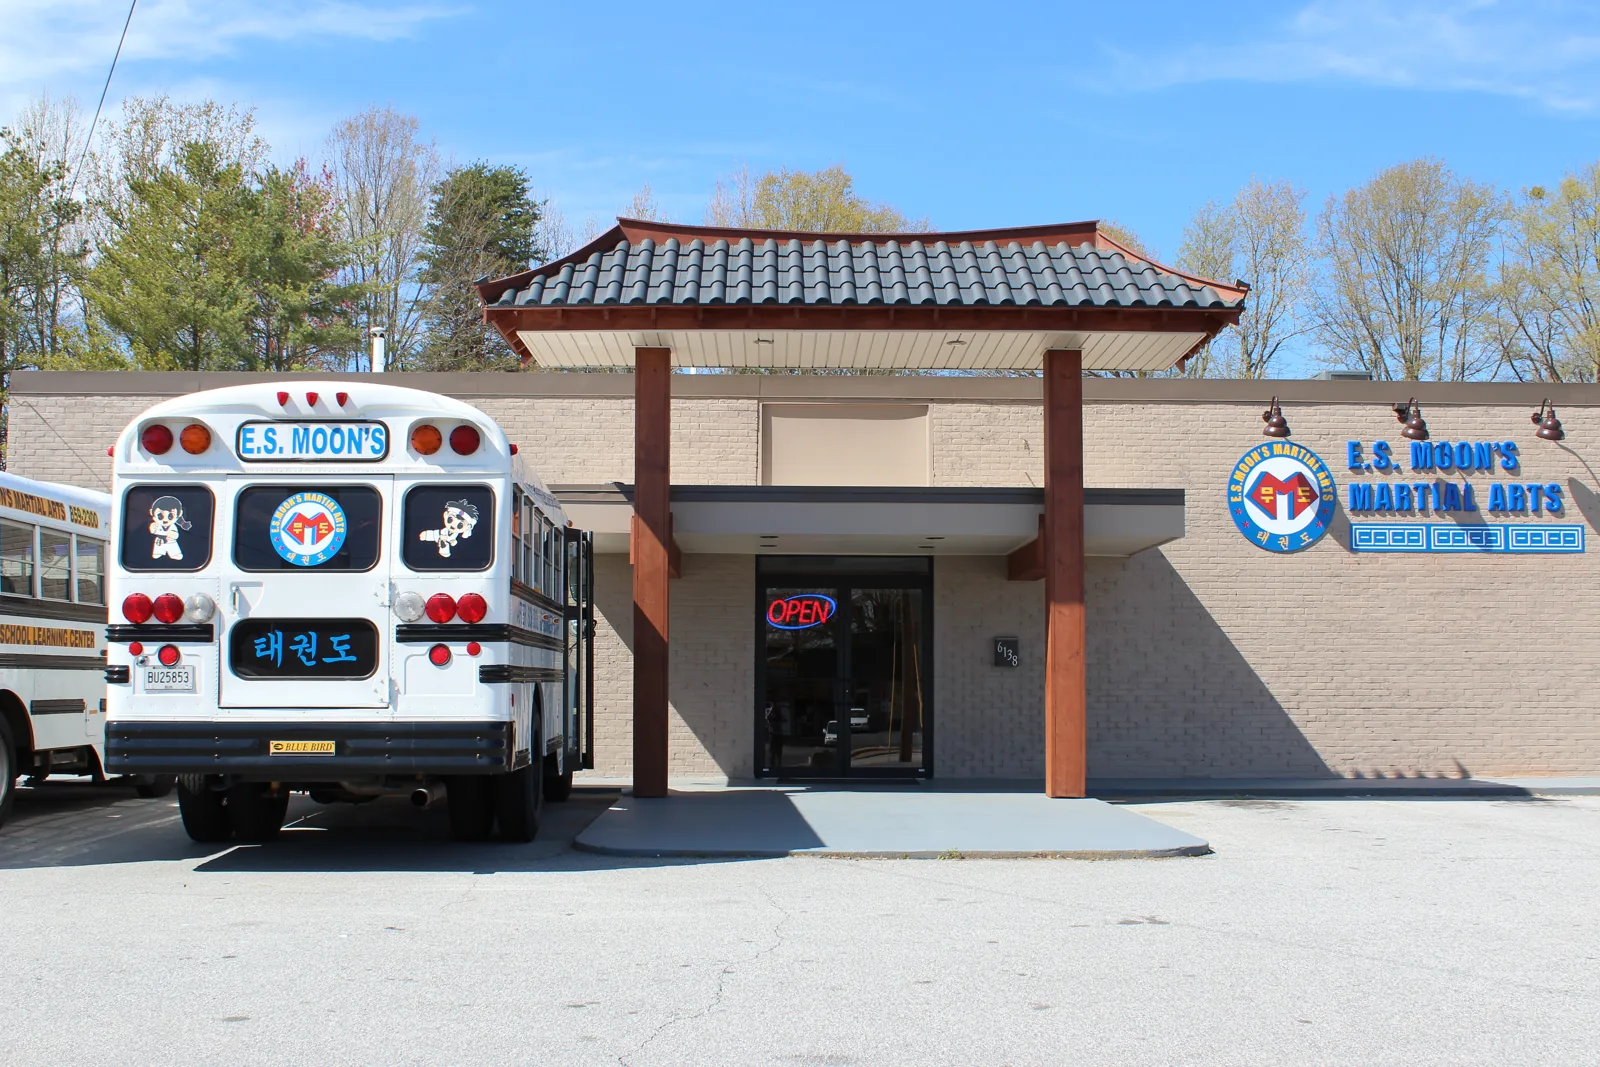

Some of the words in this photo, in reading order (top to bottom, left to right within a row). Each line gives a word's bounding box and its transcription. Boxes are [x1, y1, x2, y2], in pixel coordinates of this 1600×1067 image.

[241, 427, 283, 454] E.S.
[292, 427, 385, 454] MOON'S
[1347, 440, 1398, 470] E.S.
[1411, 440, 1519, 471] MOON'S
[1272, 443, 1322, 472] MARTIAL
[1316, 470, 1334, 501] ARTS
[13, 489, 46, 516] MARTIAL
[47, 499, 67, 521] ARTS
[69, 504, 99, 529] 859-2300
[1348, 482, 1477, 512] MARTIAL
[1488, 482, 1562, 513] ARTS
[303, 493, 338, 513] MARTIAL
[333, 511, 345, 533] ARTS
[767, 598, 830, 625] OPEN
[0, 624, 31, 645] SCHOOL
[33, 626, 68, 647] LEARNING
[69, 629, 95, 649] CENTER
[253, 629, 357, 669] 태권도
[996, 641, 1018, 667] 6138
[147, 671, 189, 683] BU25853
[285, 743, 308, 751] BLUE
[310, 743, 333, 751] BIRD
